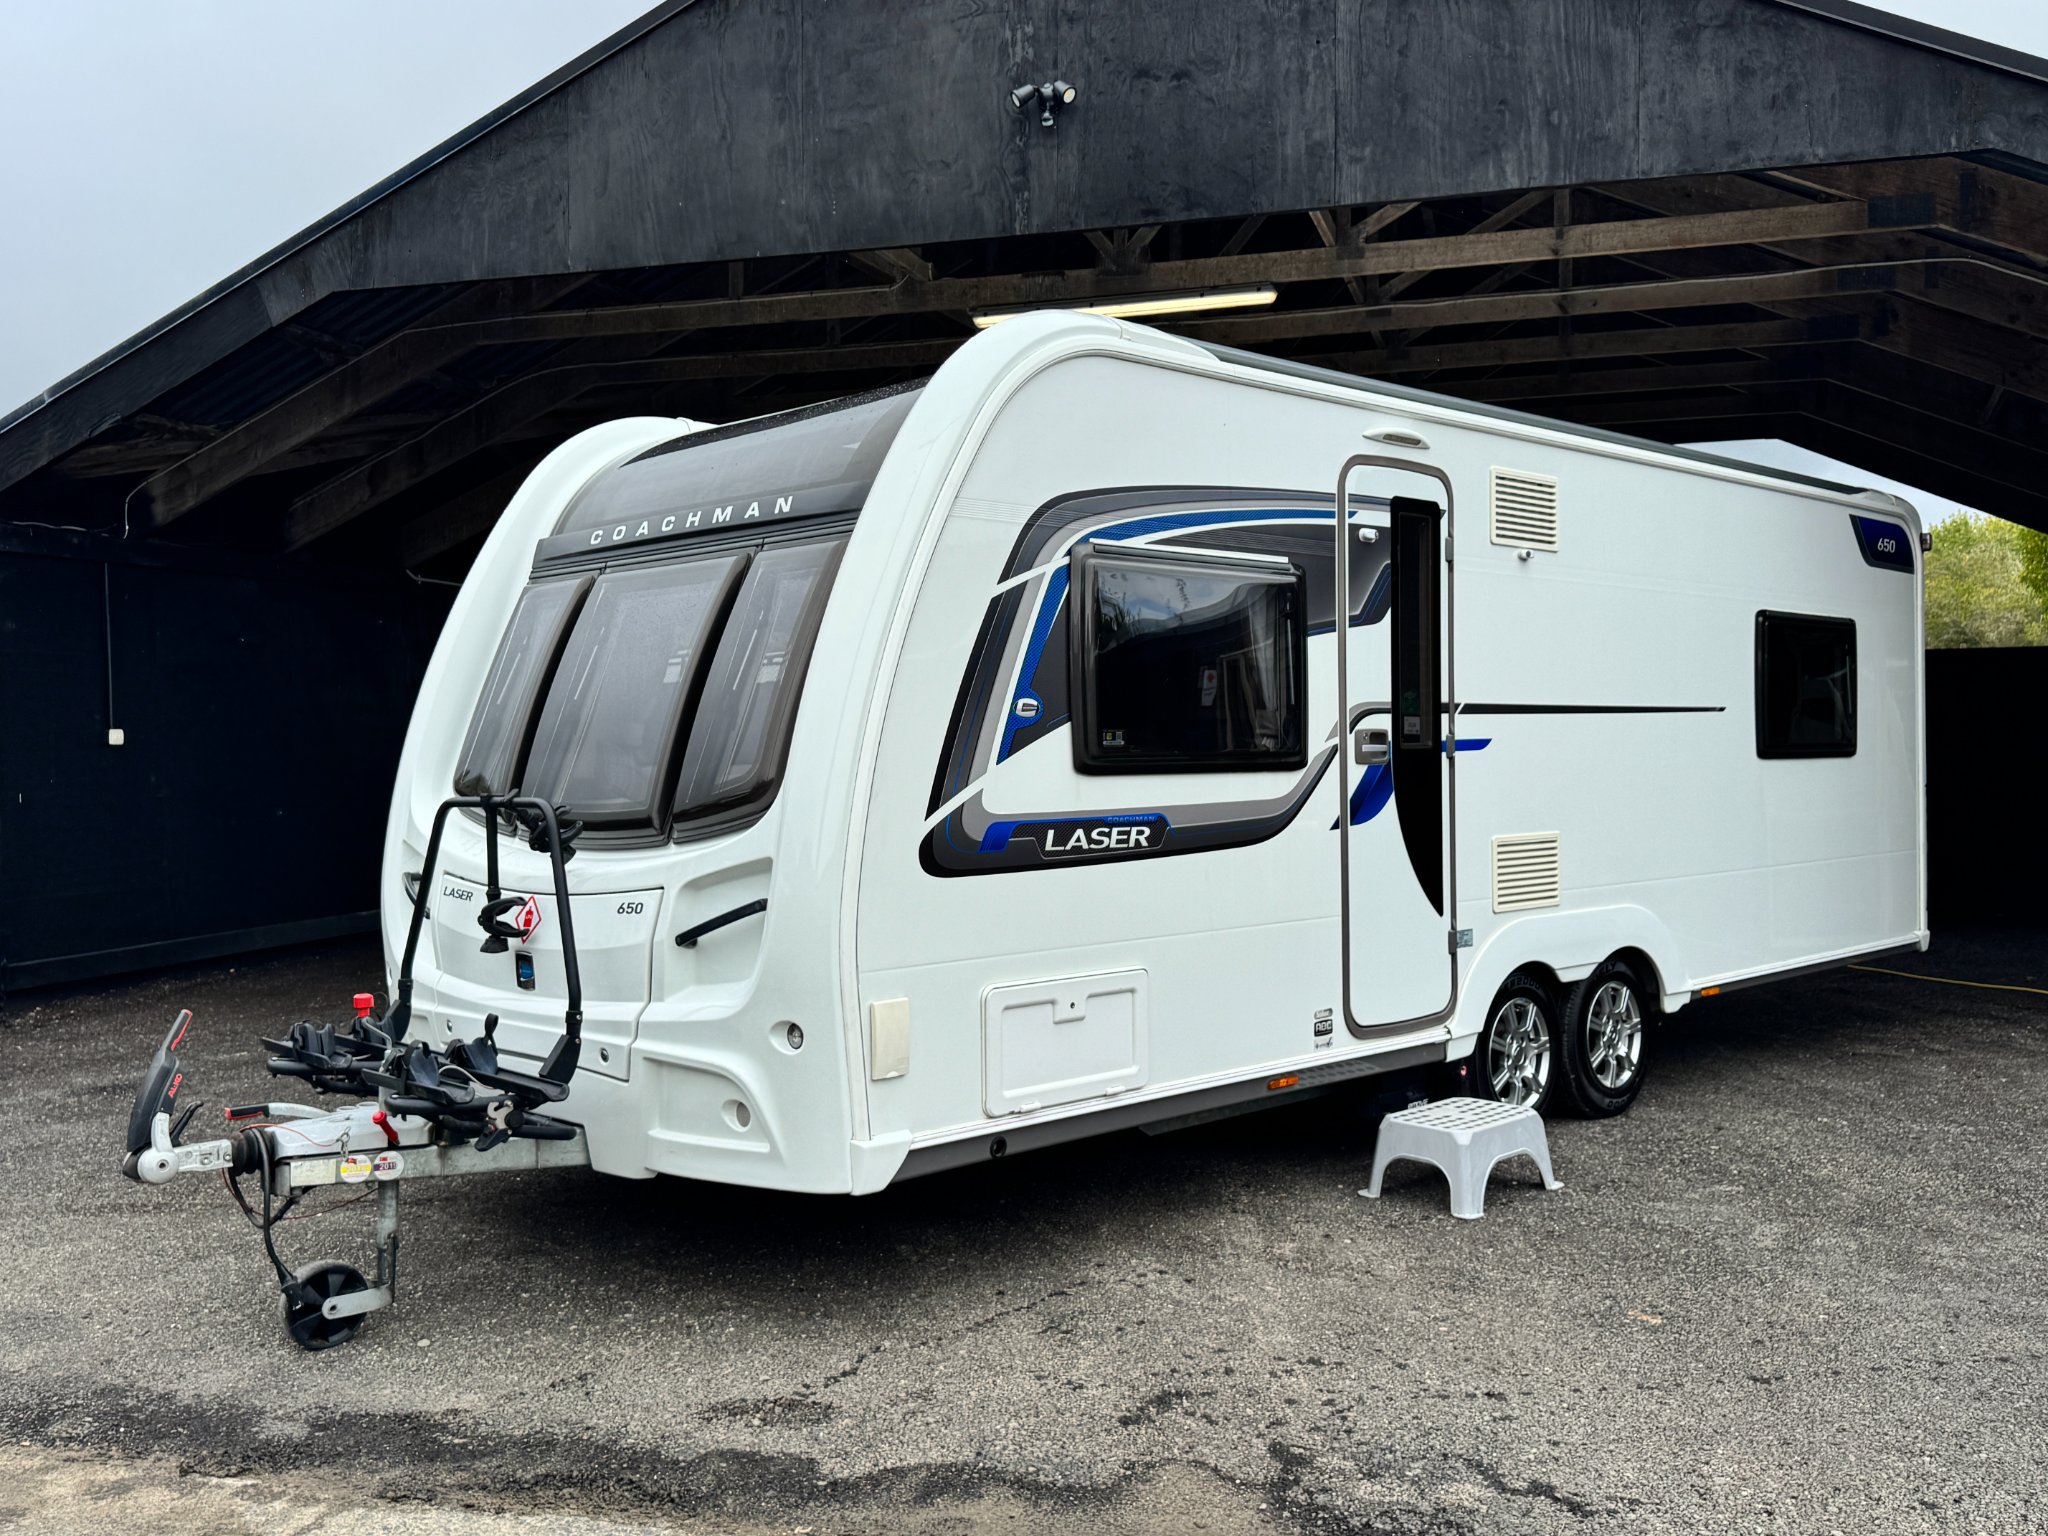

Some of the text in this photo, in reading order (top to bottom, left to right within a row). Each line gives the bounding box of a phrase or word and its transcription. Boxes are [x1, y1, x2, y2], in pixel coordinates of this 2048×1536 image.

[590, 496, 793, 545] COACHMAN
[1877, 537, 1896, 553] 650
[1107, 816, 1155, 824] COACHMAN
[1044, 826, 1151, 851] LASER
[443, 885, 474, 902] LASER
[616, 902, 644, 915] 650
